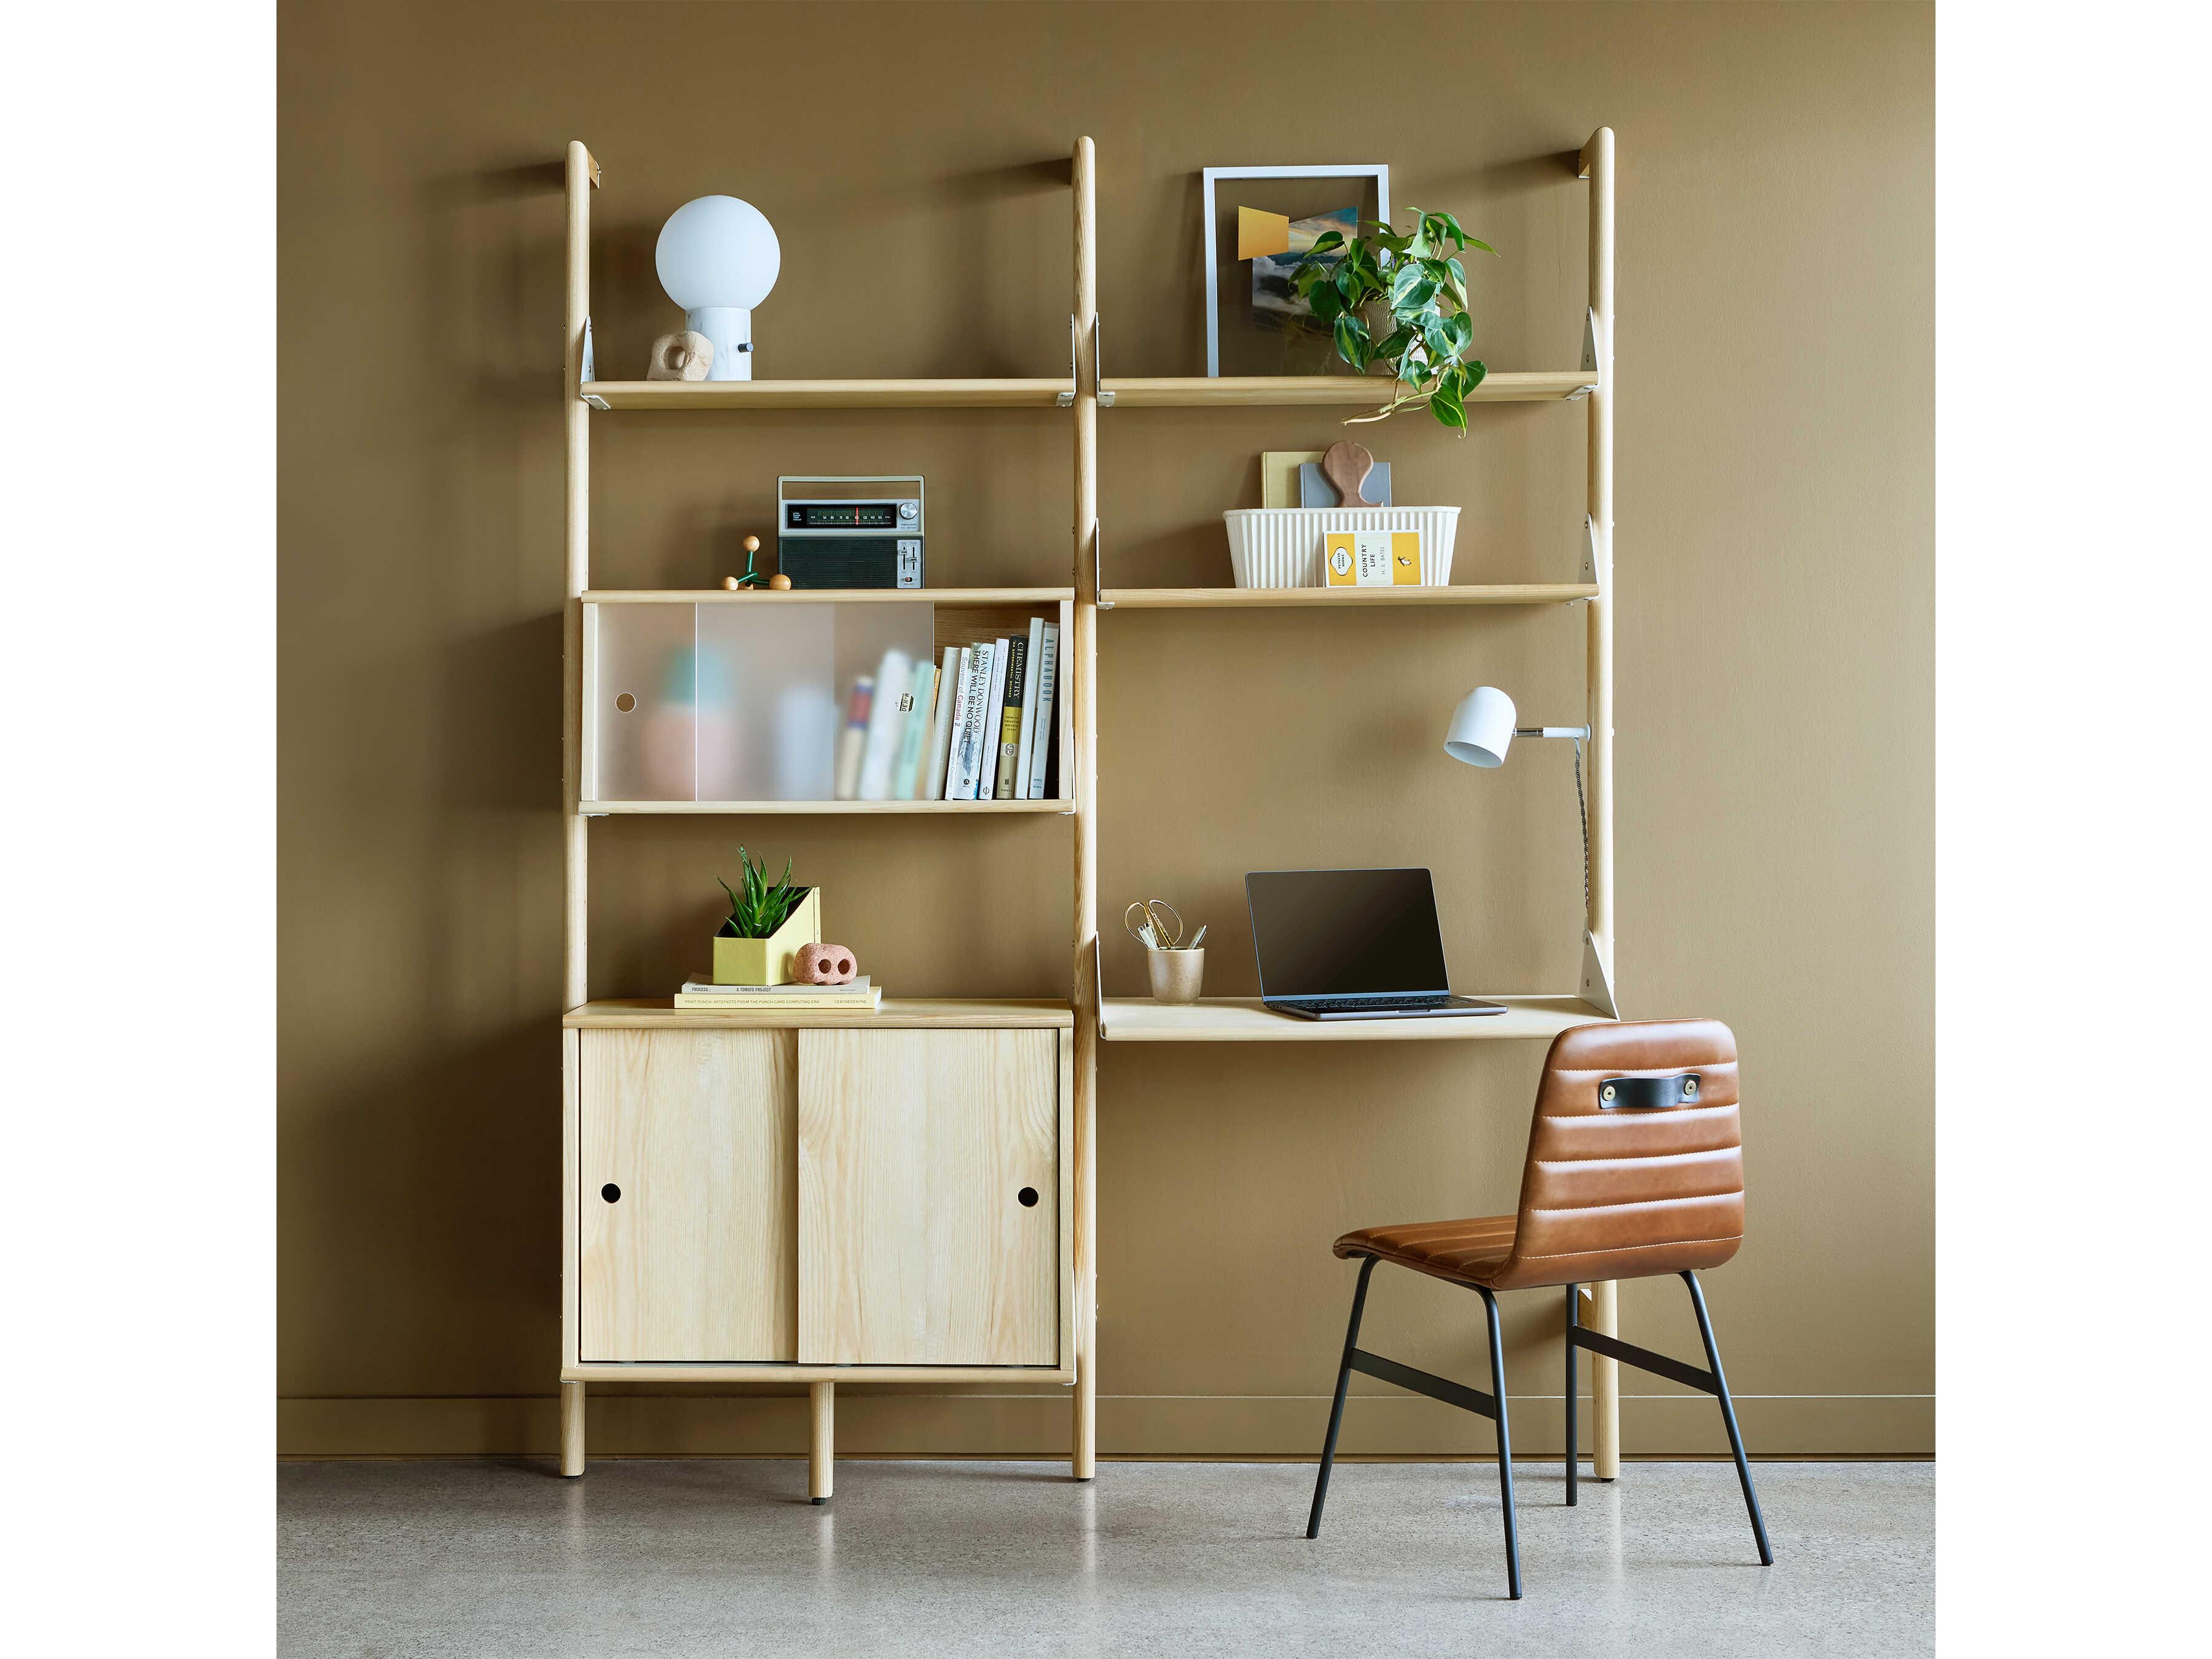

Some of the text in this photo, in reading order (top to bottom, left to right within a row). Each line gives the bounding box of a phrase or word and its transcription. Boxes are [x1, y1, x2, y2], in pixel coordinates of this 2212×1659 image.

[959, 657, 968, 686] Souvenir
[963, 650, 981, 744] THERE WILL BE NO QUIET
[973, 650, 989, 733] STANLEY DONWOOD
[1014, 642, 1024, 699] CHEMISTRY
[1043, 639, 1054, 702] ALPHABOOK
[955, 695, 963, 721] Canada
